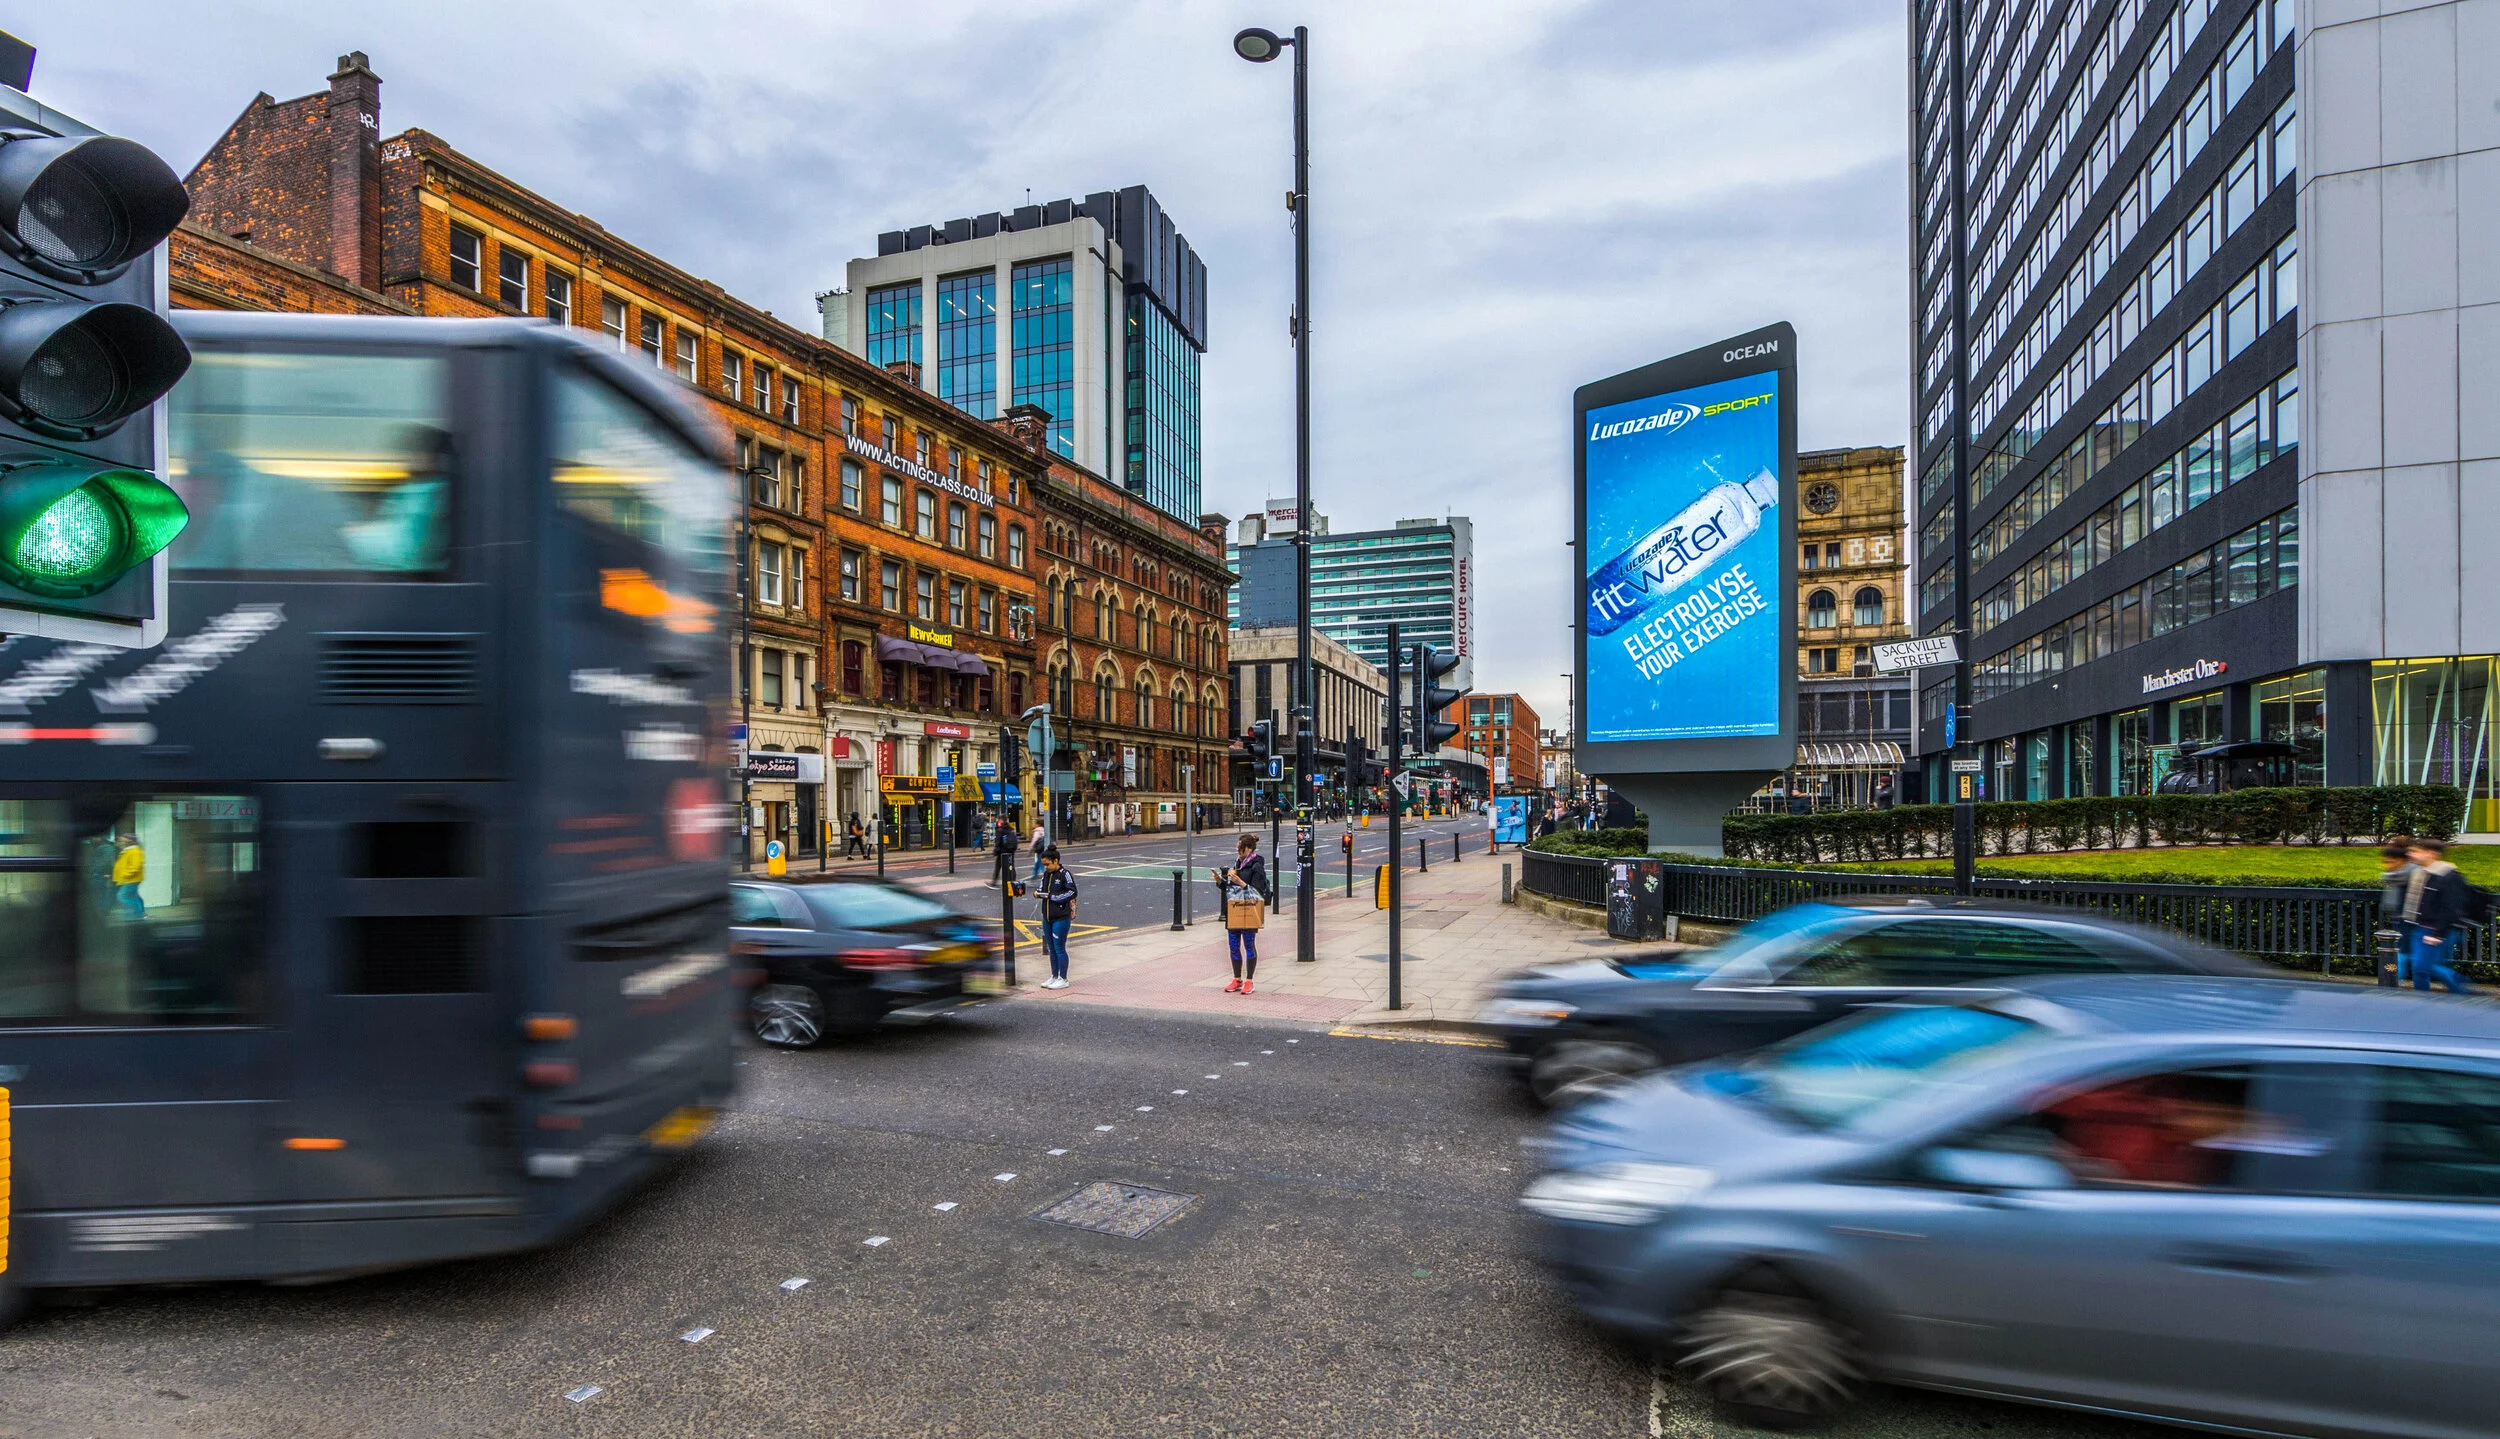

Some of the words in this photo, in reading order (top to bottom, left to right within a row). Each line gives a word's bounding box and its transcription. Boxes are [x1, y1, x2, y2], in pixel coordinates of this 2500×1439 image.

[1723, 340, 1778, 363] OCEAN
[1590, 408, 1683, 441] Lucozade
[1703, 393, 1774, 417] SPORT
[847, 434, 994, 508] WWW.ACTINGCLASS.CO.UK
[1620, 533, 1673, 577] Lucozade
[1459, 557, 1467, 592] HOTEL
[1622, 562, 1754, 661] ELECTROLYSE
[1635, 641, 1685, 681] YOUR
[1680, 586, 1768, 654] EXERCISE
[1881, 638, 1947, 657] SACKVILLE
[1894, 651, 1939, 668] STREET
[2143, 668, 2195, 694] Manchester
[2195, 658, 2219, 679] One
[749, 760, 768, 774] okyo
